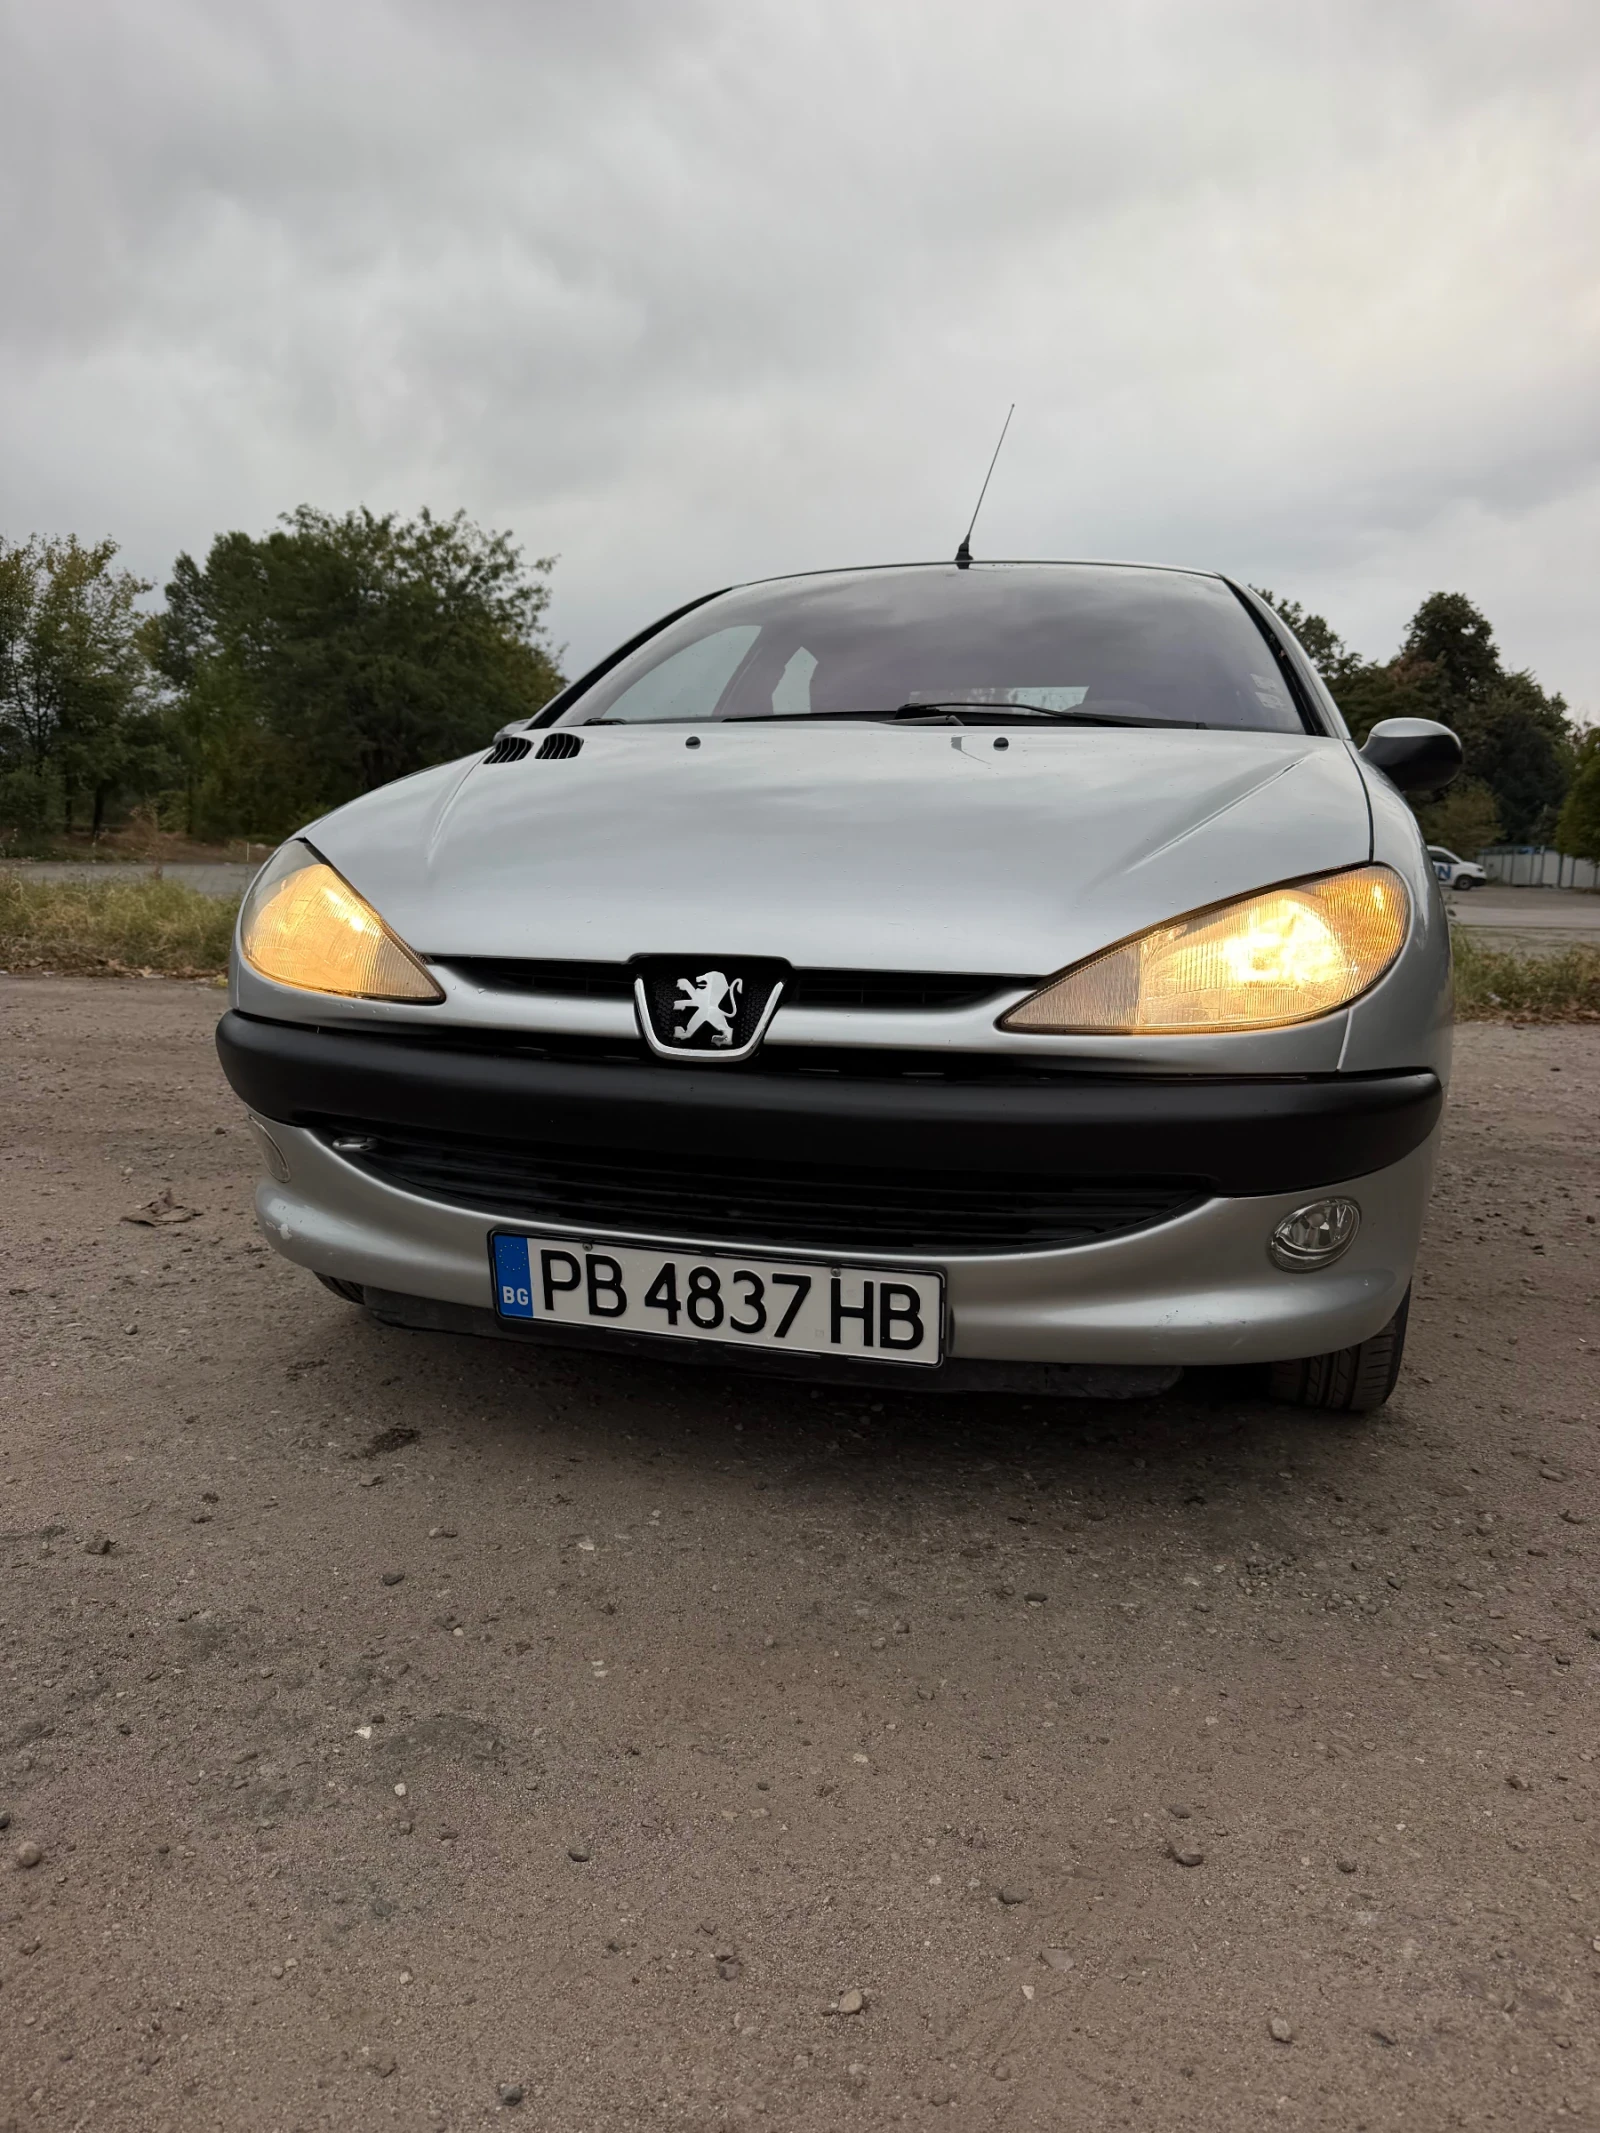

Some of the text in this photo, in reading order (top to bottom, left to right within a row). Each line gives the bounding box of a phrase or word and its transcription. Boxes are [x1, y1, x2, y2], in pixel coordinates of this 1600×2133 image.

[503, 1286, 529, 1306] BG
[540, 1249, 925, 1350] PB 4837 HB
